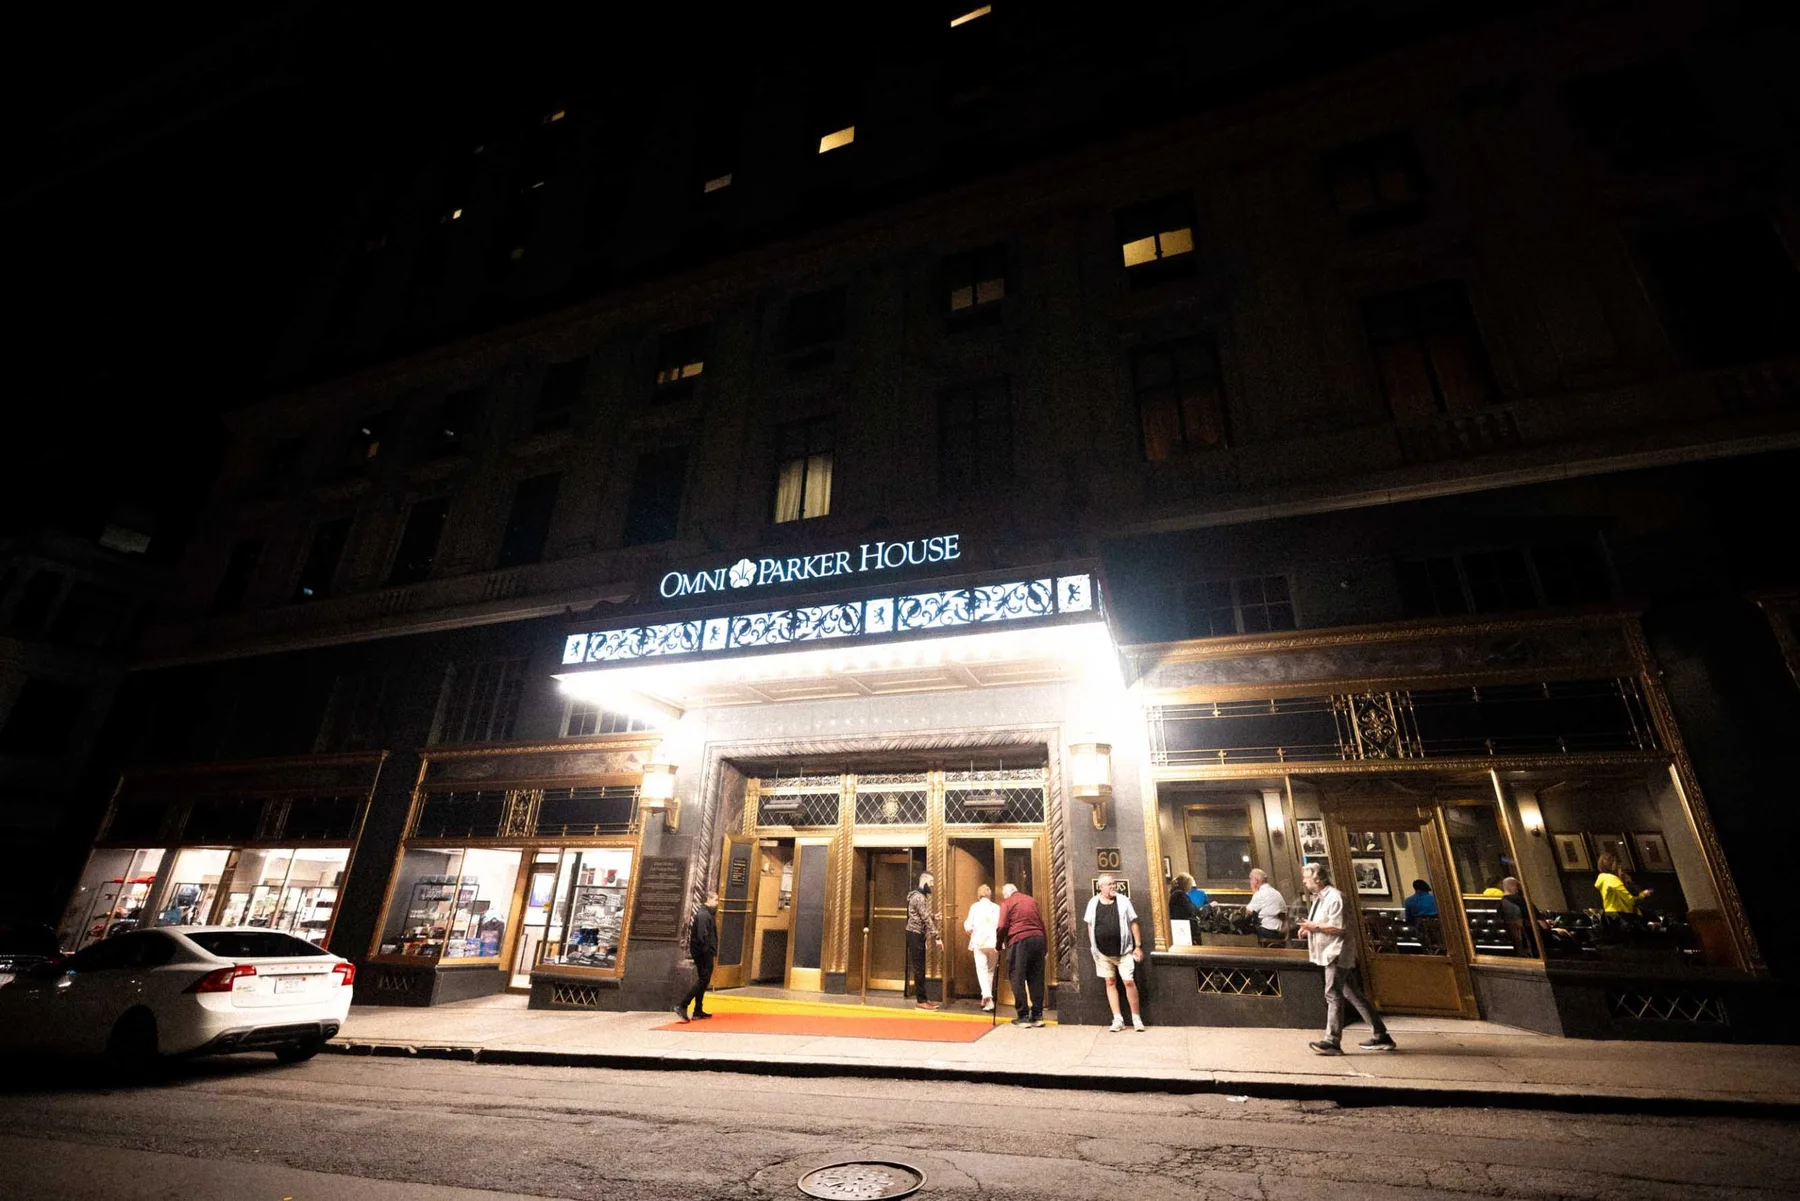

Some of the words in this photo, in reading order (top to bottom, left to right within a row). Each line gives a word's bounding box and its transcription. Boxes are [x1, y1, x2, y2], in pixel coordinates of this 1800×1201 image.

[659, 567, 728, 599] OMNI
[757, 550, 854, 586] PARKER
[858, 533, 961, 572] HOUSE
[1098, 851, 1119, 868] 60
